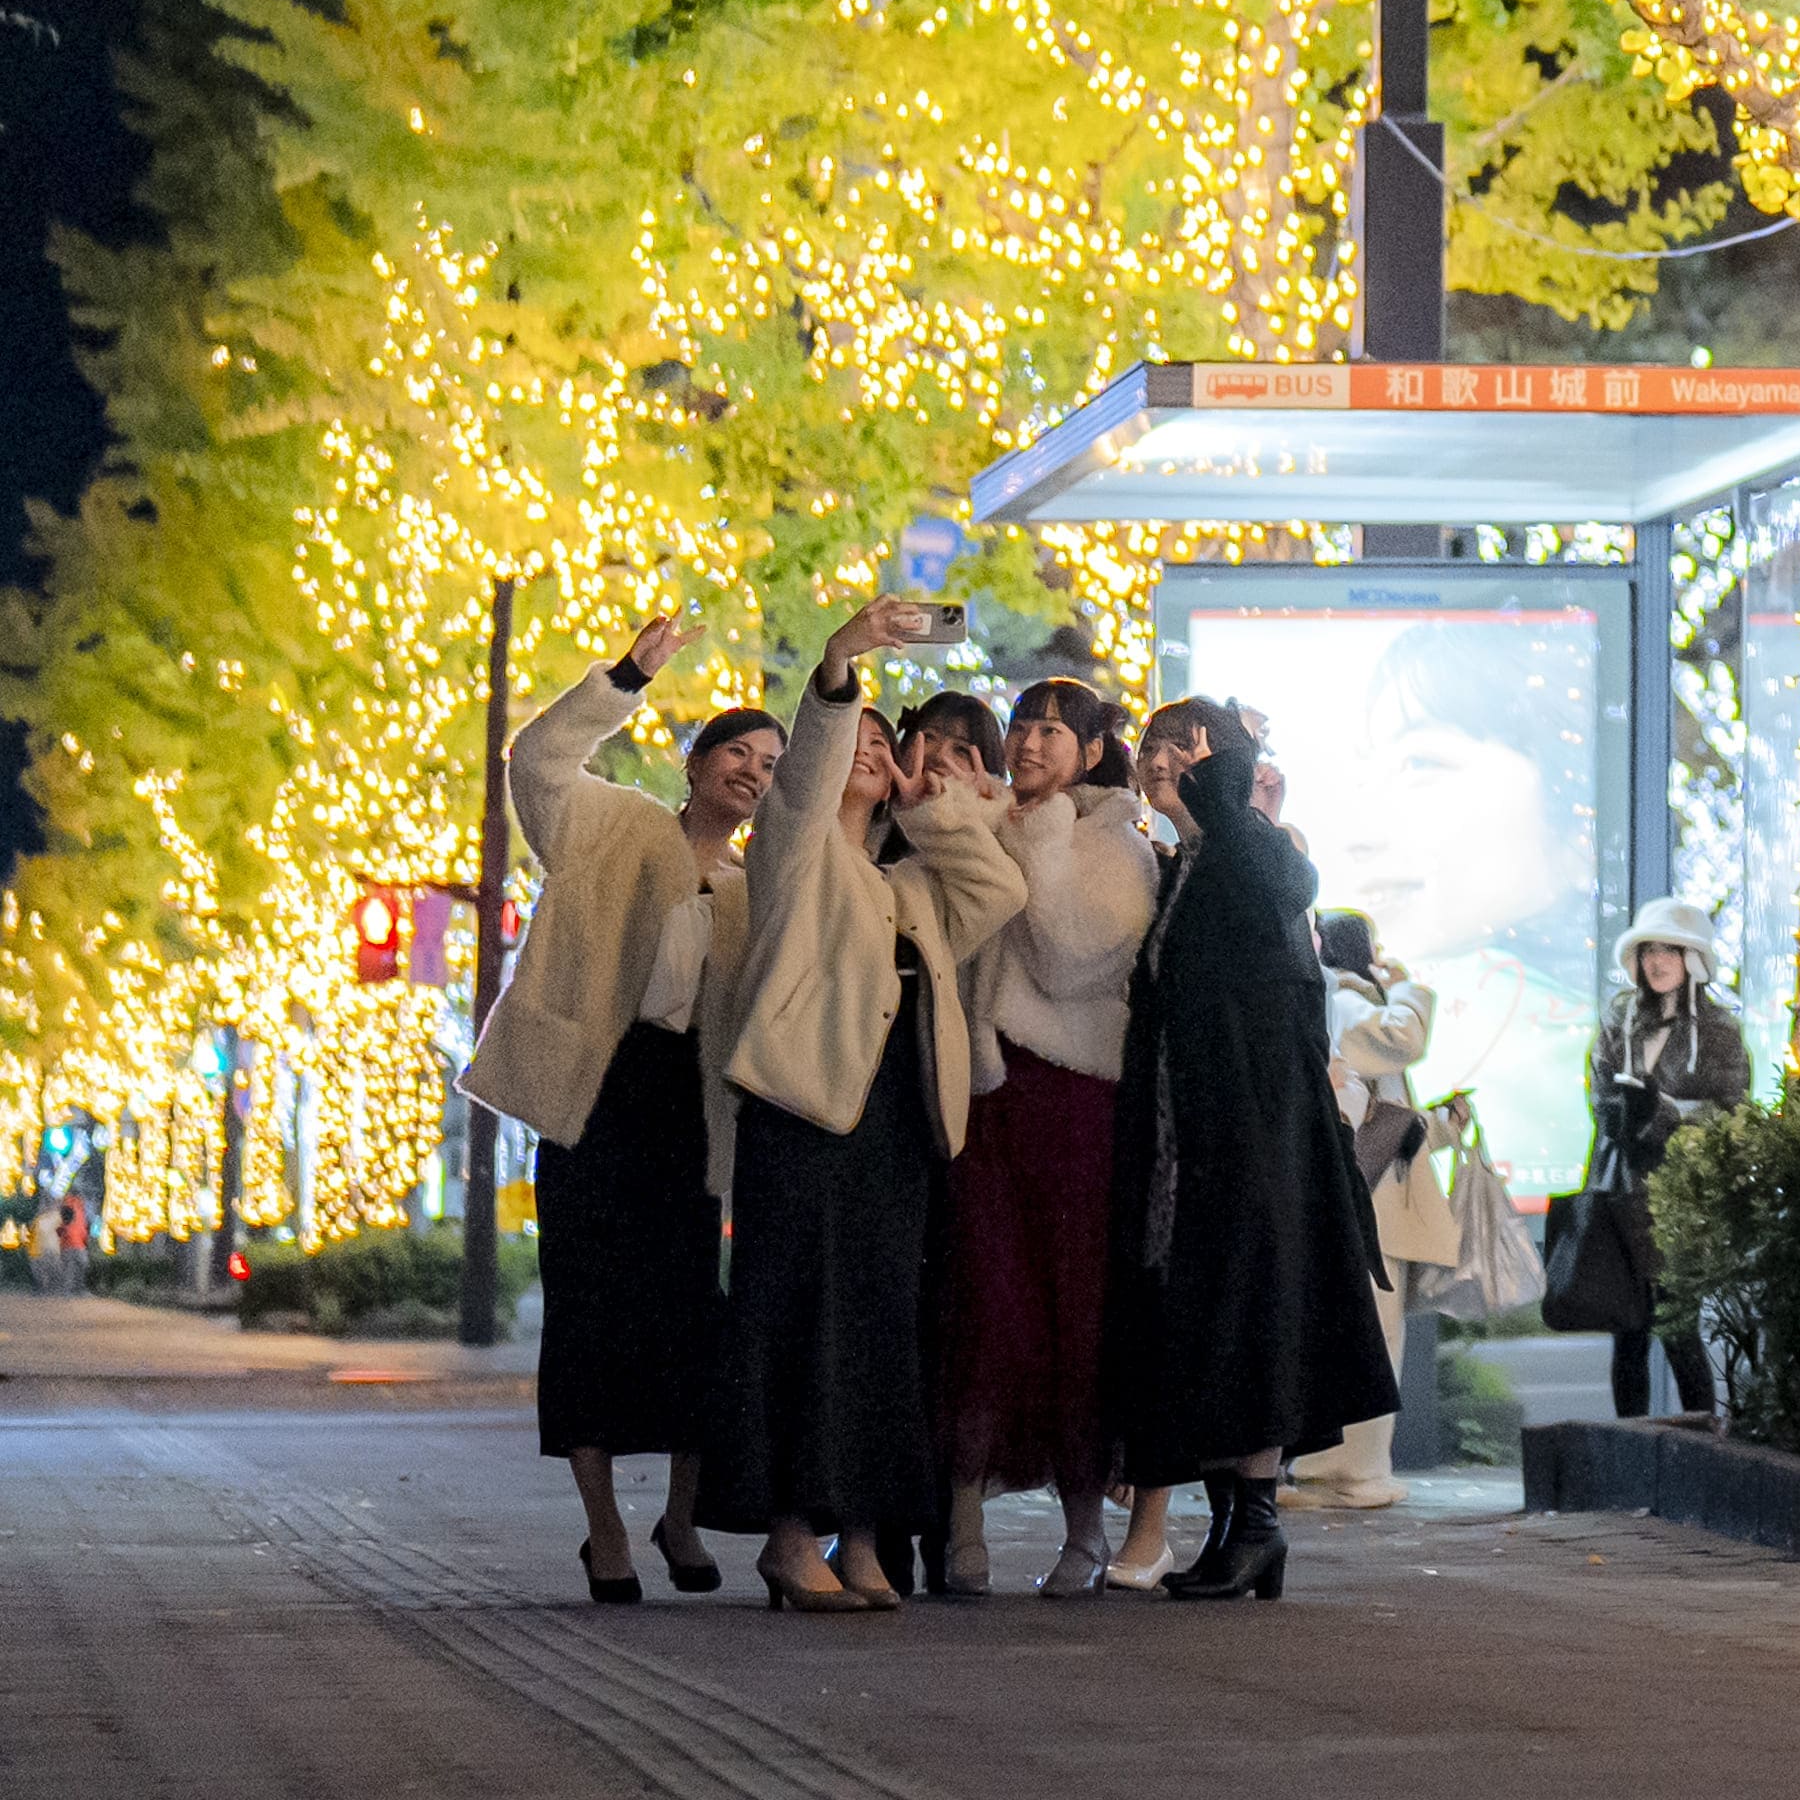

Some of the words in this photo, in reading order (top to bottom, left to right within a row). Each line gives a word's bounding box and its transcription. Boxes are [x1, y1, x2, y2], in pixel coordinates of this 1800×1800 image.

[1274, 373, 1333, 398] BUS
[1385, 366, 1643, 409] 和歌山城前
